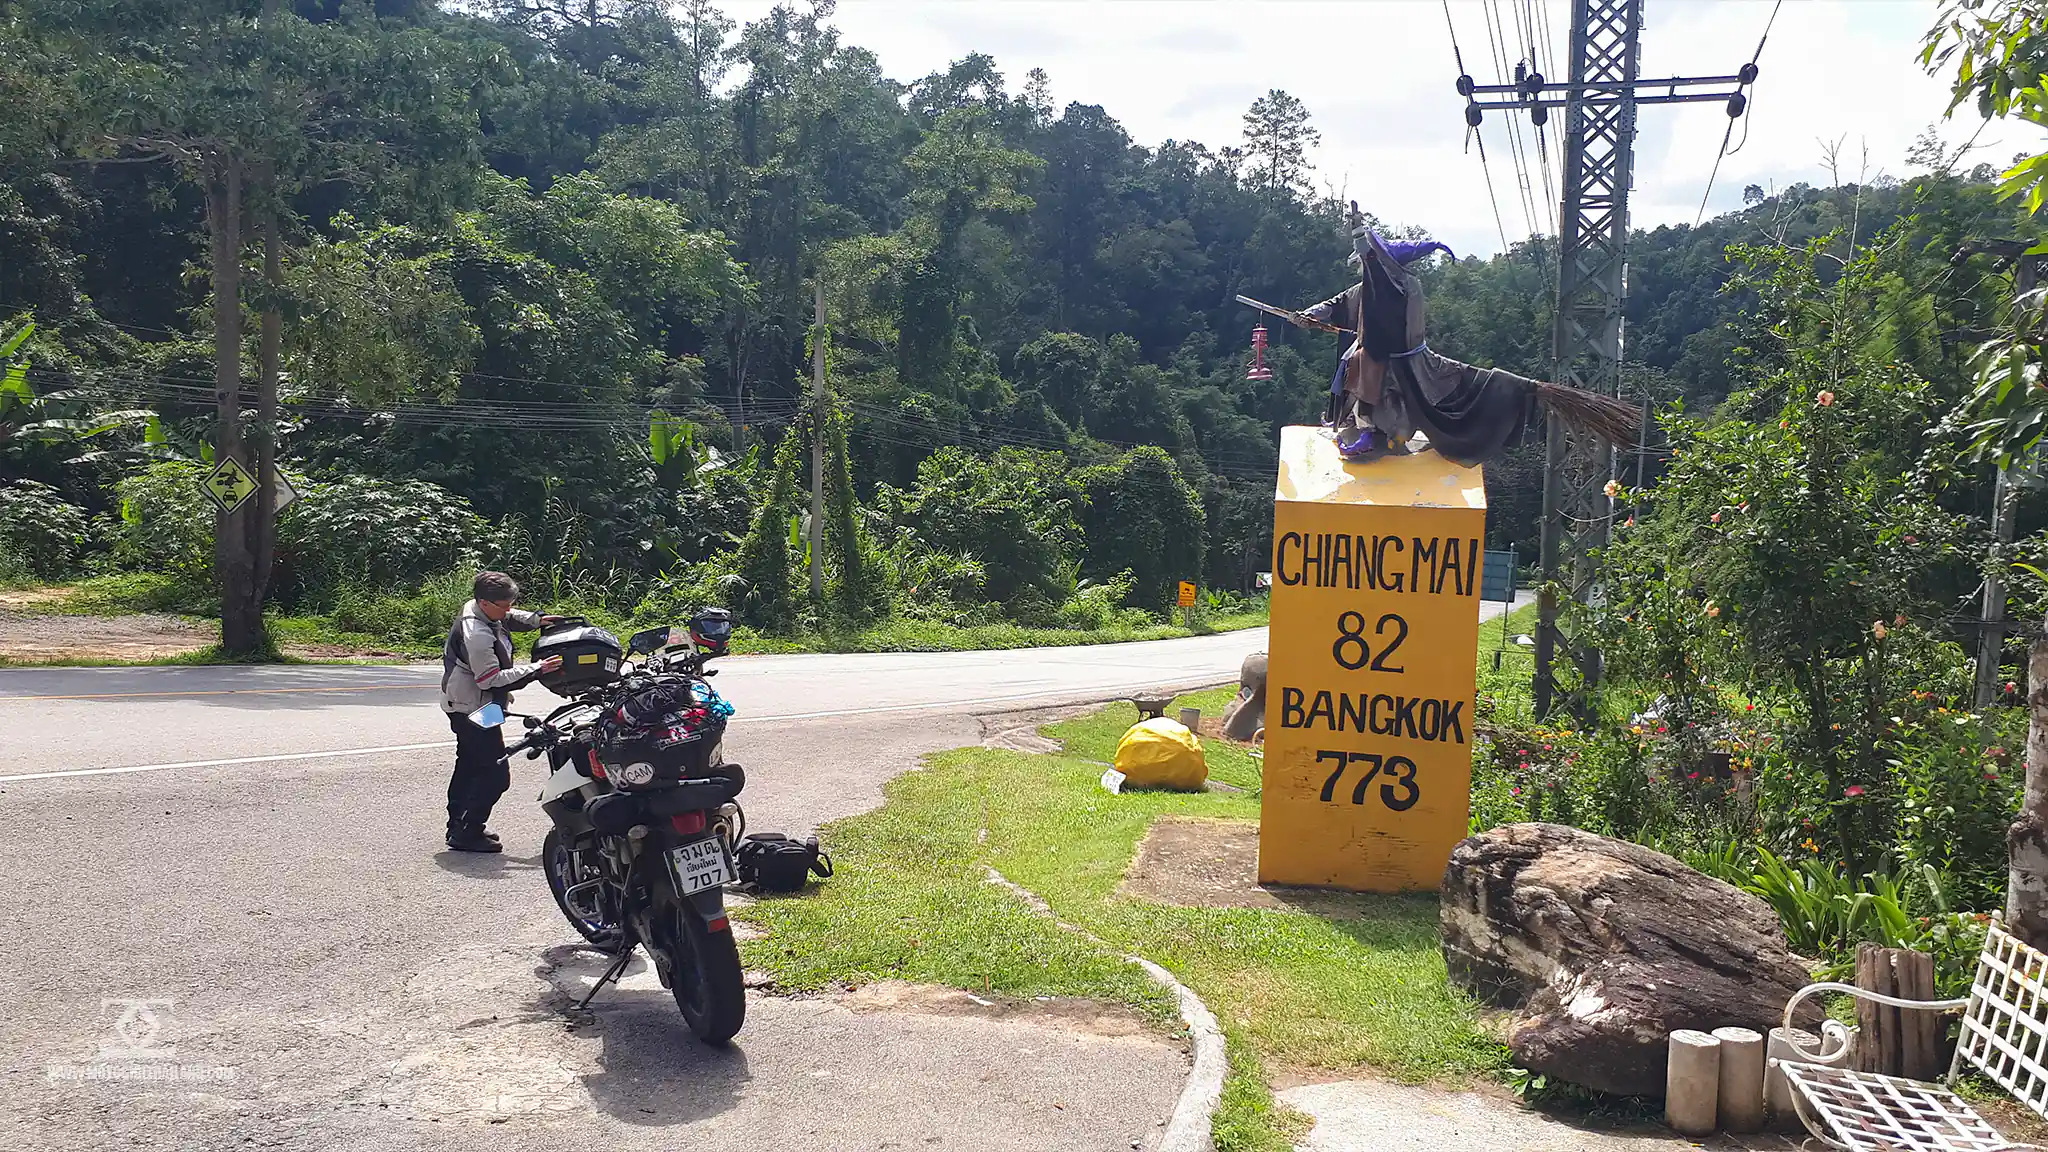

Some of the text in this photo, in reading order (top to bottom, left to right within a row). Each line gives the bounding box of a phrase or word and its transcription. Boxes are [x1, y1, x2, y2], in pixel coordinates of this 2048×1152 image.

[1277, 531, 1479, 597] CHIANG MAI
[1332, 610, 1409, 674] 82
[1280, 686, 1465, 745] BANGKOK
[627, 765, 652, 782] CAM
[1315, 750, 1420, 812] 773
[688, 868, 722, 890] 707
